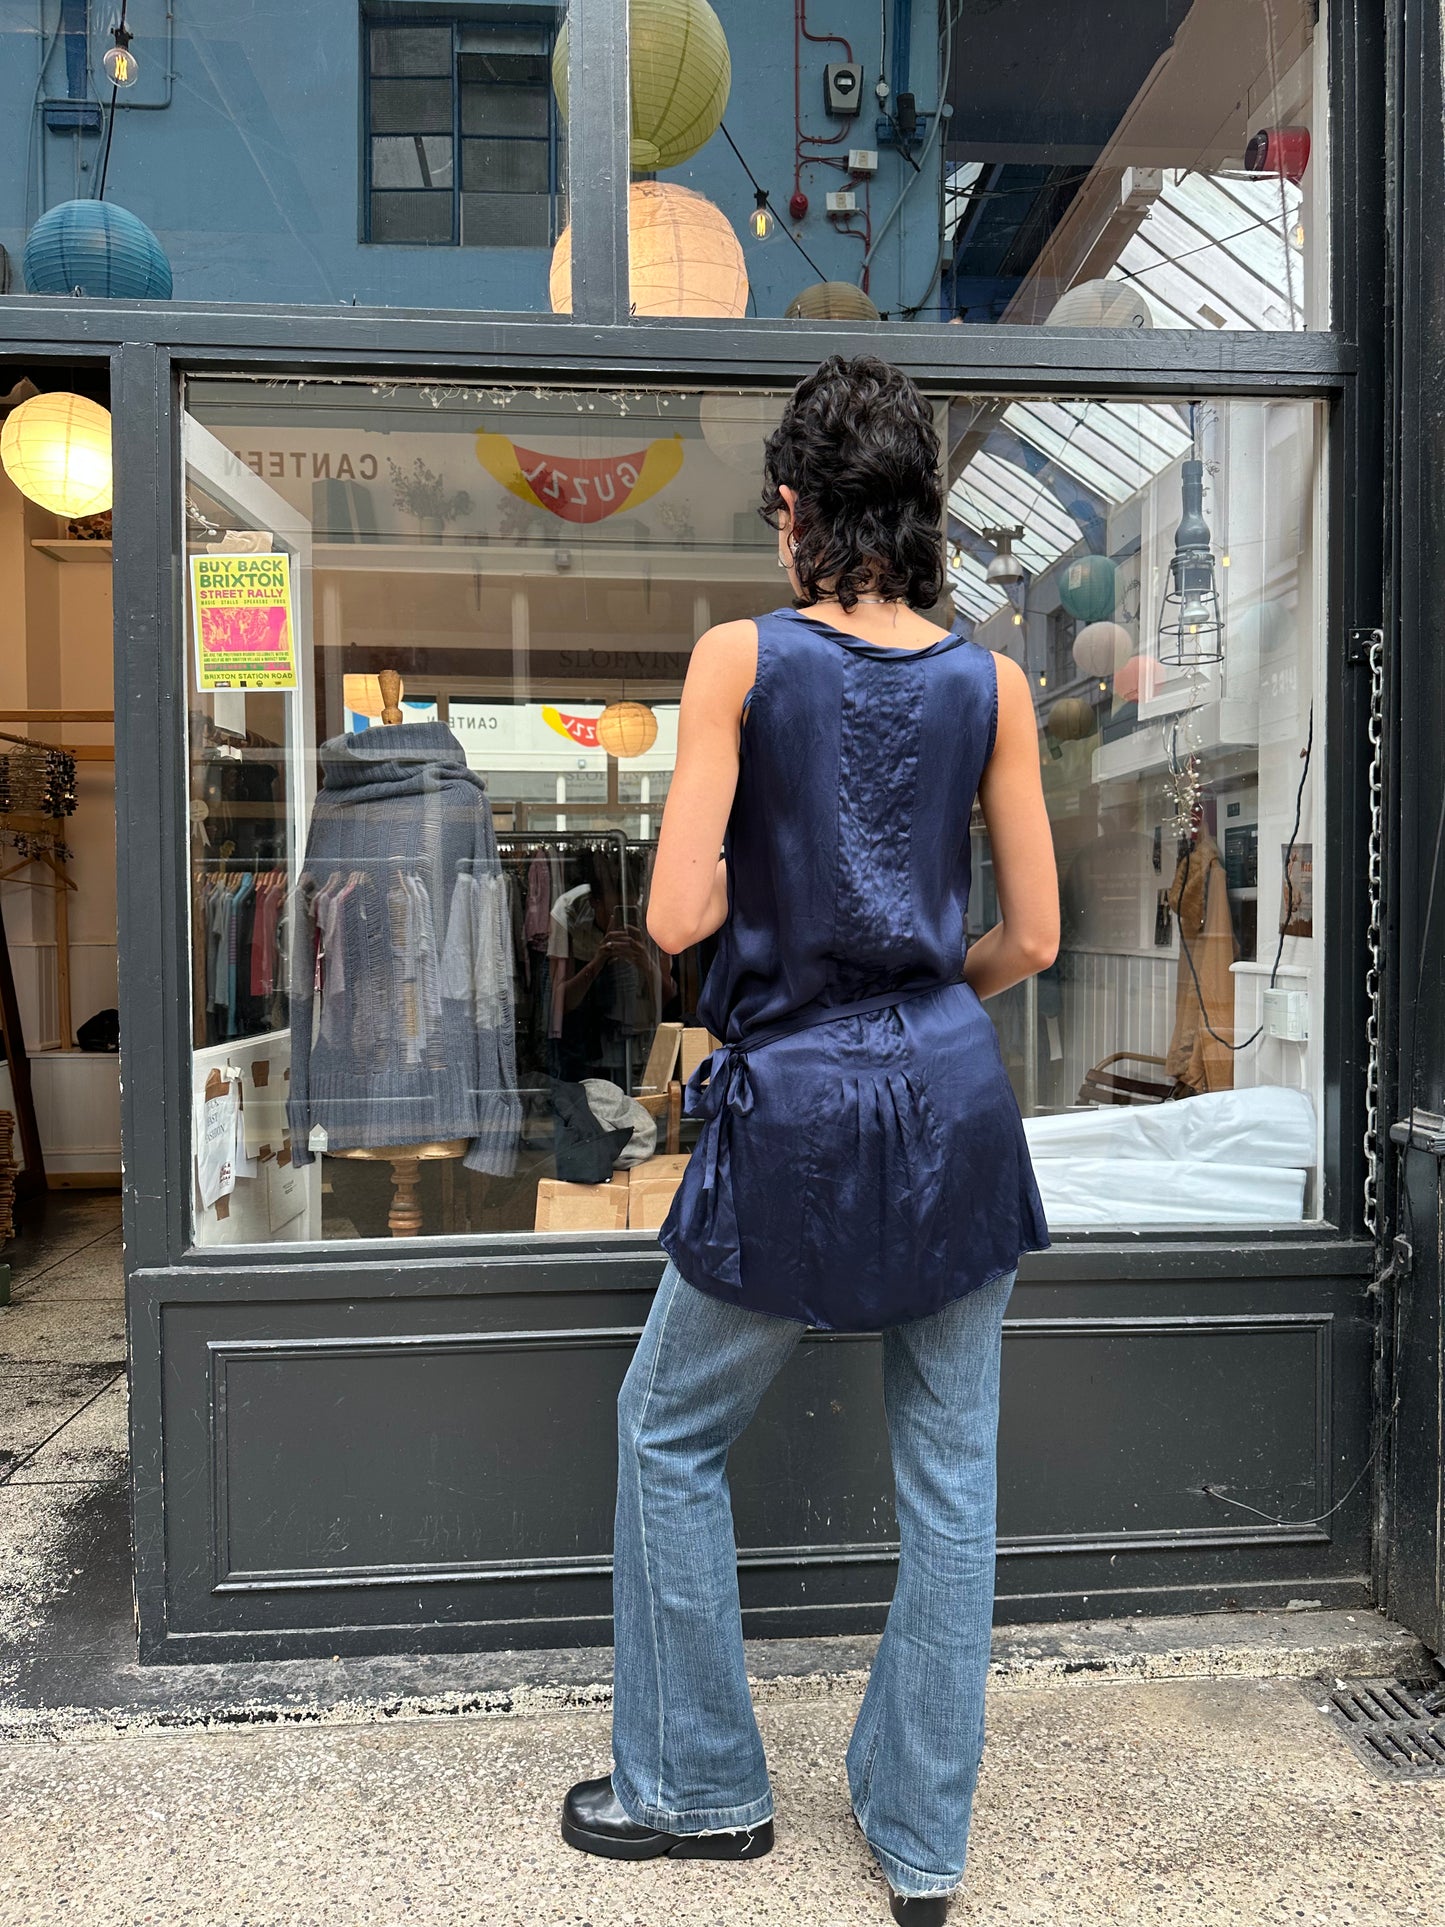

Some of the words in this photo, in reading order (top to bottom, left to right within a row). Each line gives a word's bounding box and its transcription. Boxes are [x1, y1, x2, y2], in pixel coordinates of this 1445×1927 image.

[199, 561, 232, 573] BUY
[238, 560, 283, 572] BACK
[200, 573, 285, 588] BRIXTON
[200, 589, 244, 599] STREET
[247, 589, 284, 598] RALLY
